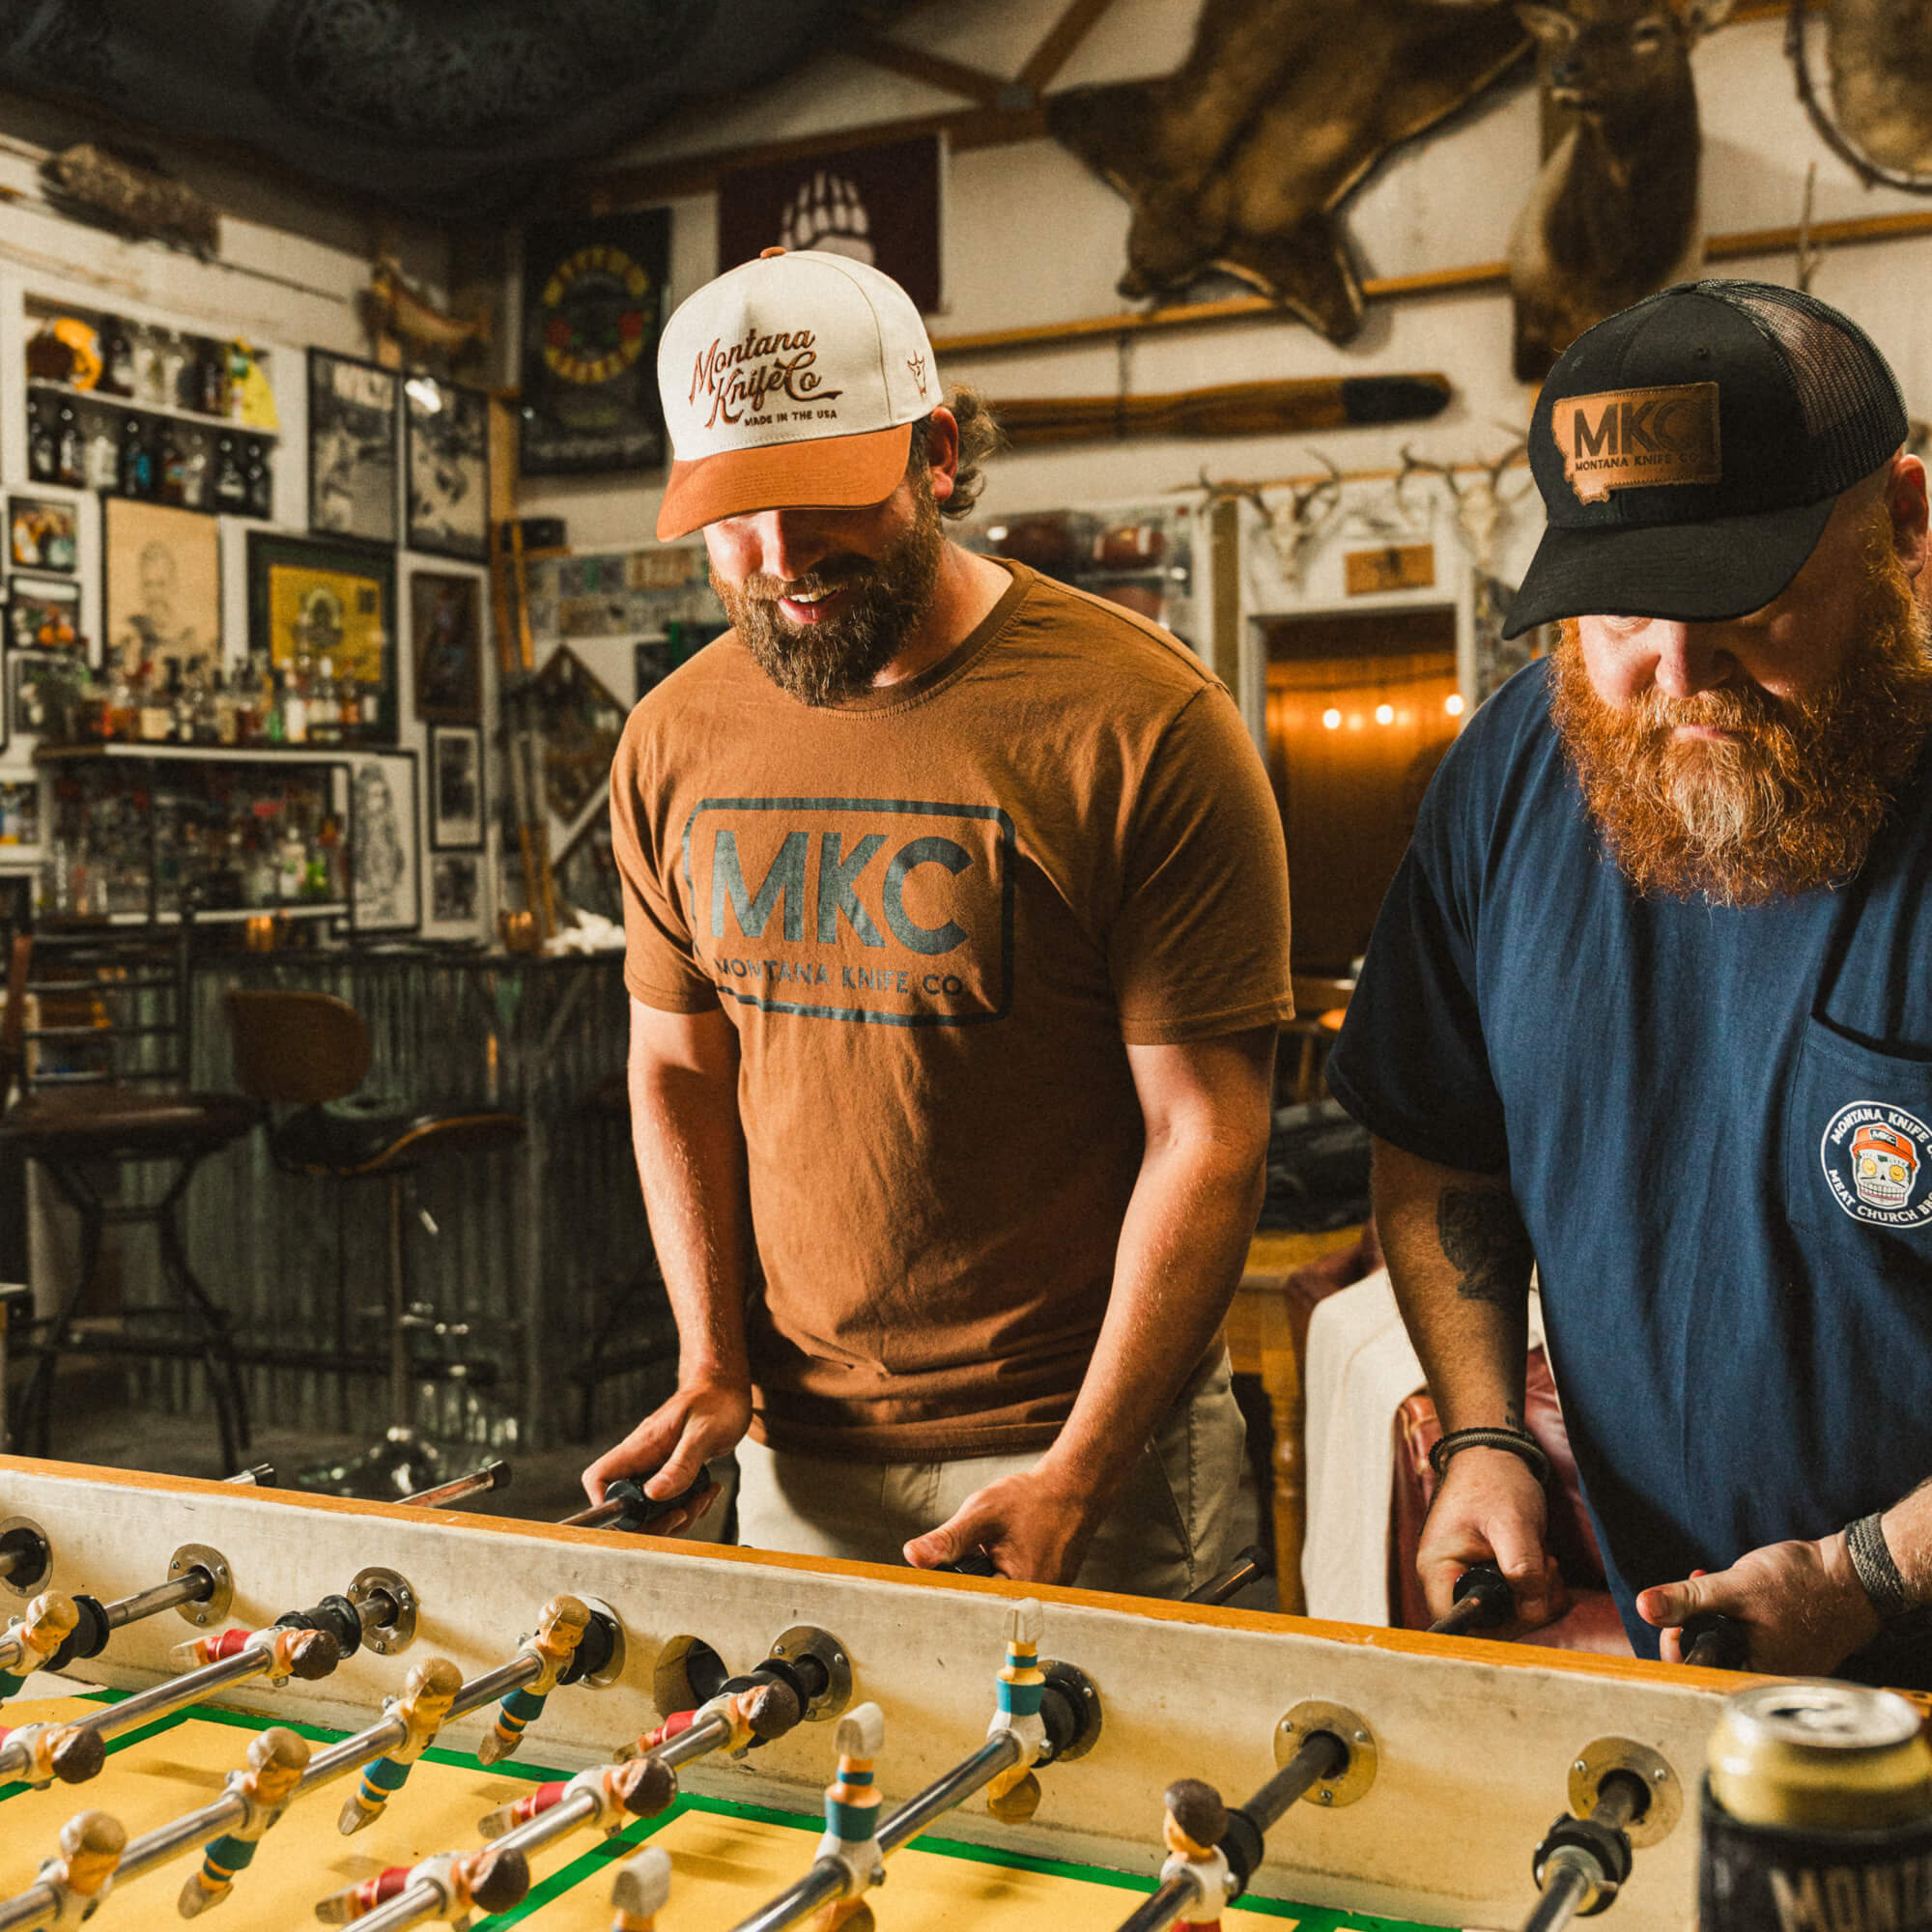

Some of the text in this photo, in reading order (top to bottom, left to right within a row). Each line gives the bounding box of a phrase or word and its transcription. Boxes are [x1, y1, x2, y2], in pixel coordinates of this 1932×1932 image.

[689, 327, 816, 406] Montana
[704, 364, 786, 430] Knife
[744, 410, 838, 426] MADE IN THE USA
[1575, 399, 1702, 459] MKC
[1575, 457, 1629, 471] MONTANA
[1634, 454, 1672, 467] KNIFE
[711, 830, 975, 956] MKC
[714, 957, 831, 986] MONTANA
[842, 965, 909, 995] KNIFE
[1830, 1108, 1884, 1145] MONTANA
[1889, 1111, 1929, 1143] KNIFE
[1829, 1169, 1856, 1208] MEAT
[1857, 1205, 1919, 1223] CHURCH
